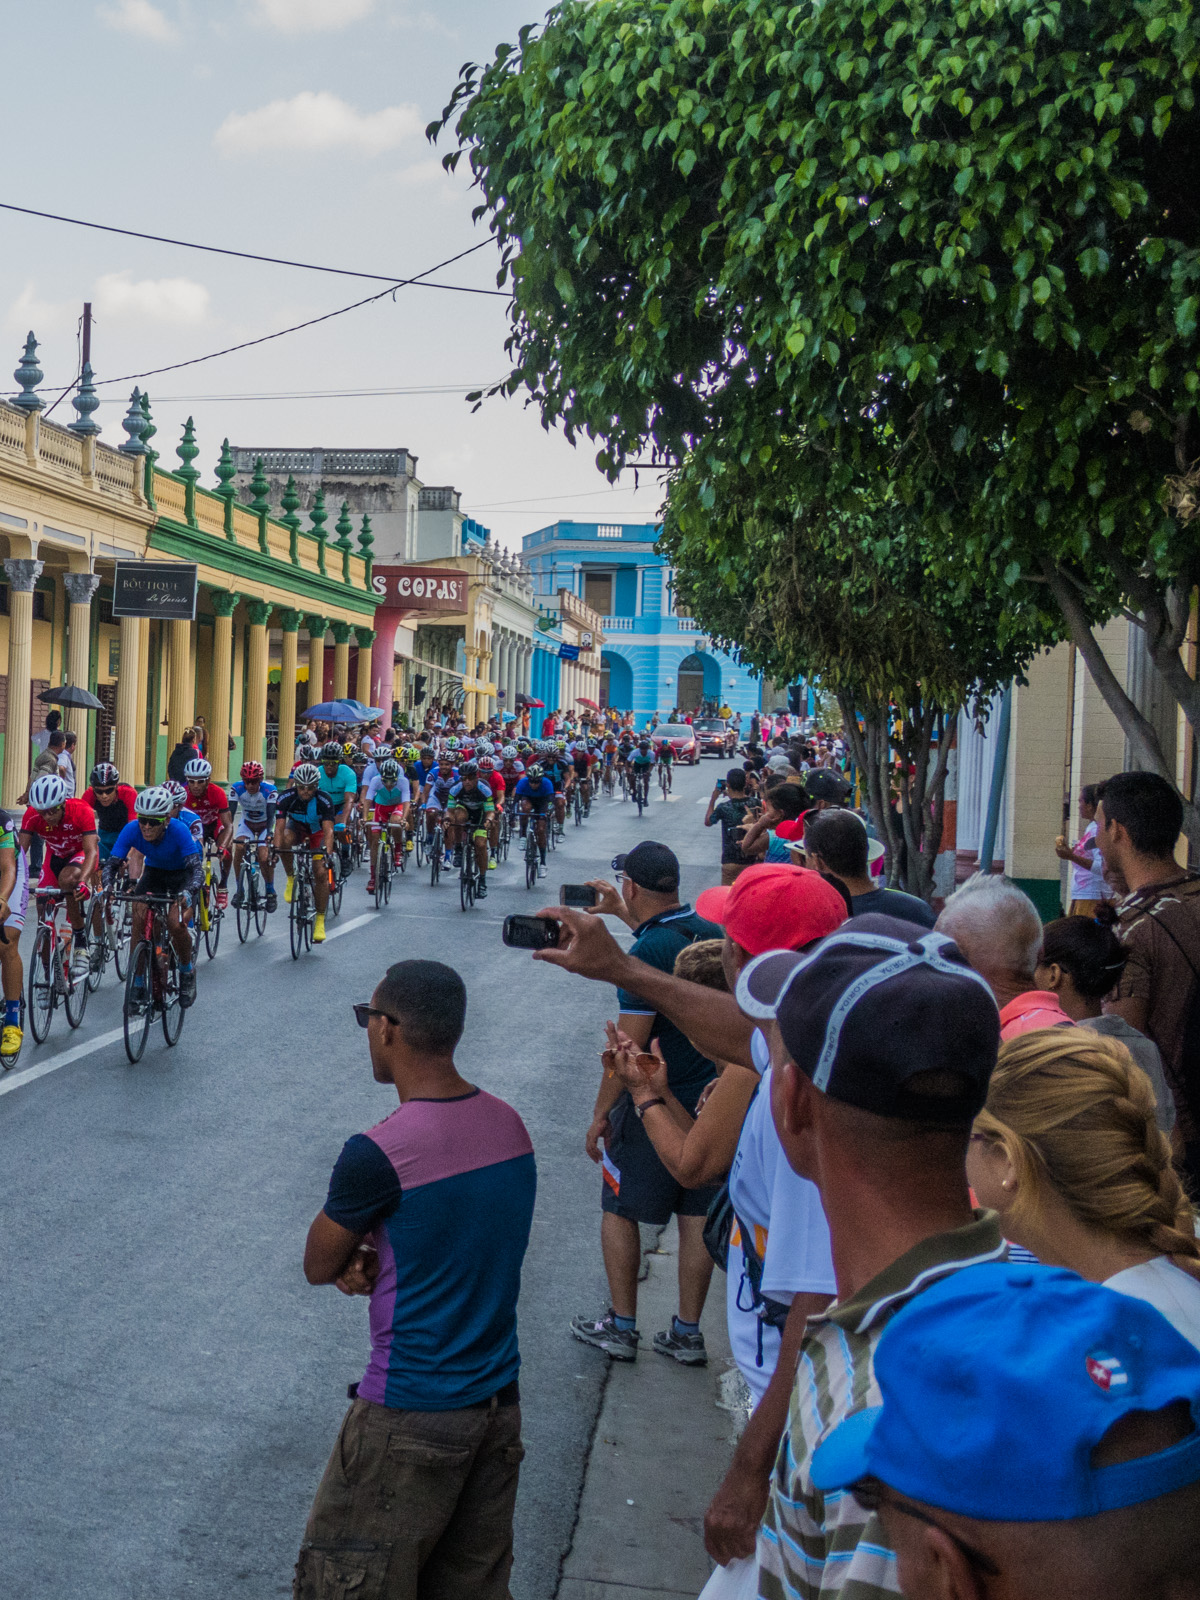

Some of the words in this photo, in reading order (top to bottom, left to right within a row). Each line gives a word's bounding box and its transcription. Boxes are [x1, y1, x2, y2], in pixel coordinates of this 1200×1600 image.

[398, 577, 457, 600] COPAS
[838, 978, 870, 1013] FLORIDA
[822, 1025, 838, 1064] FLORIDA
